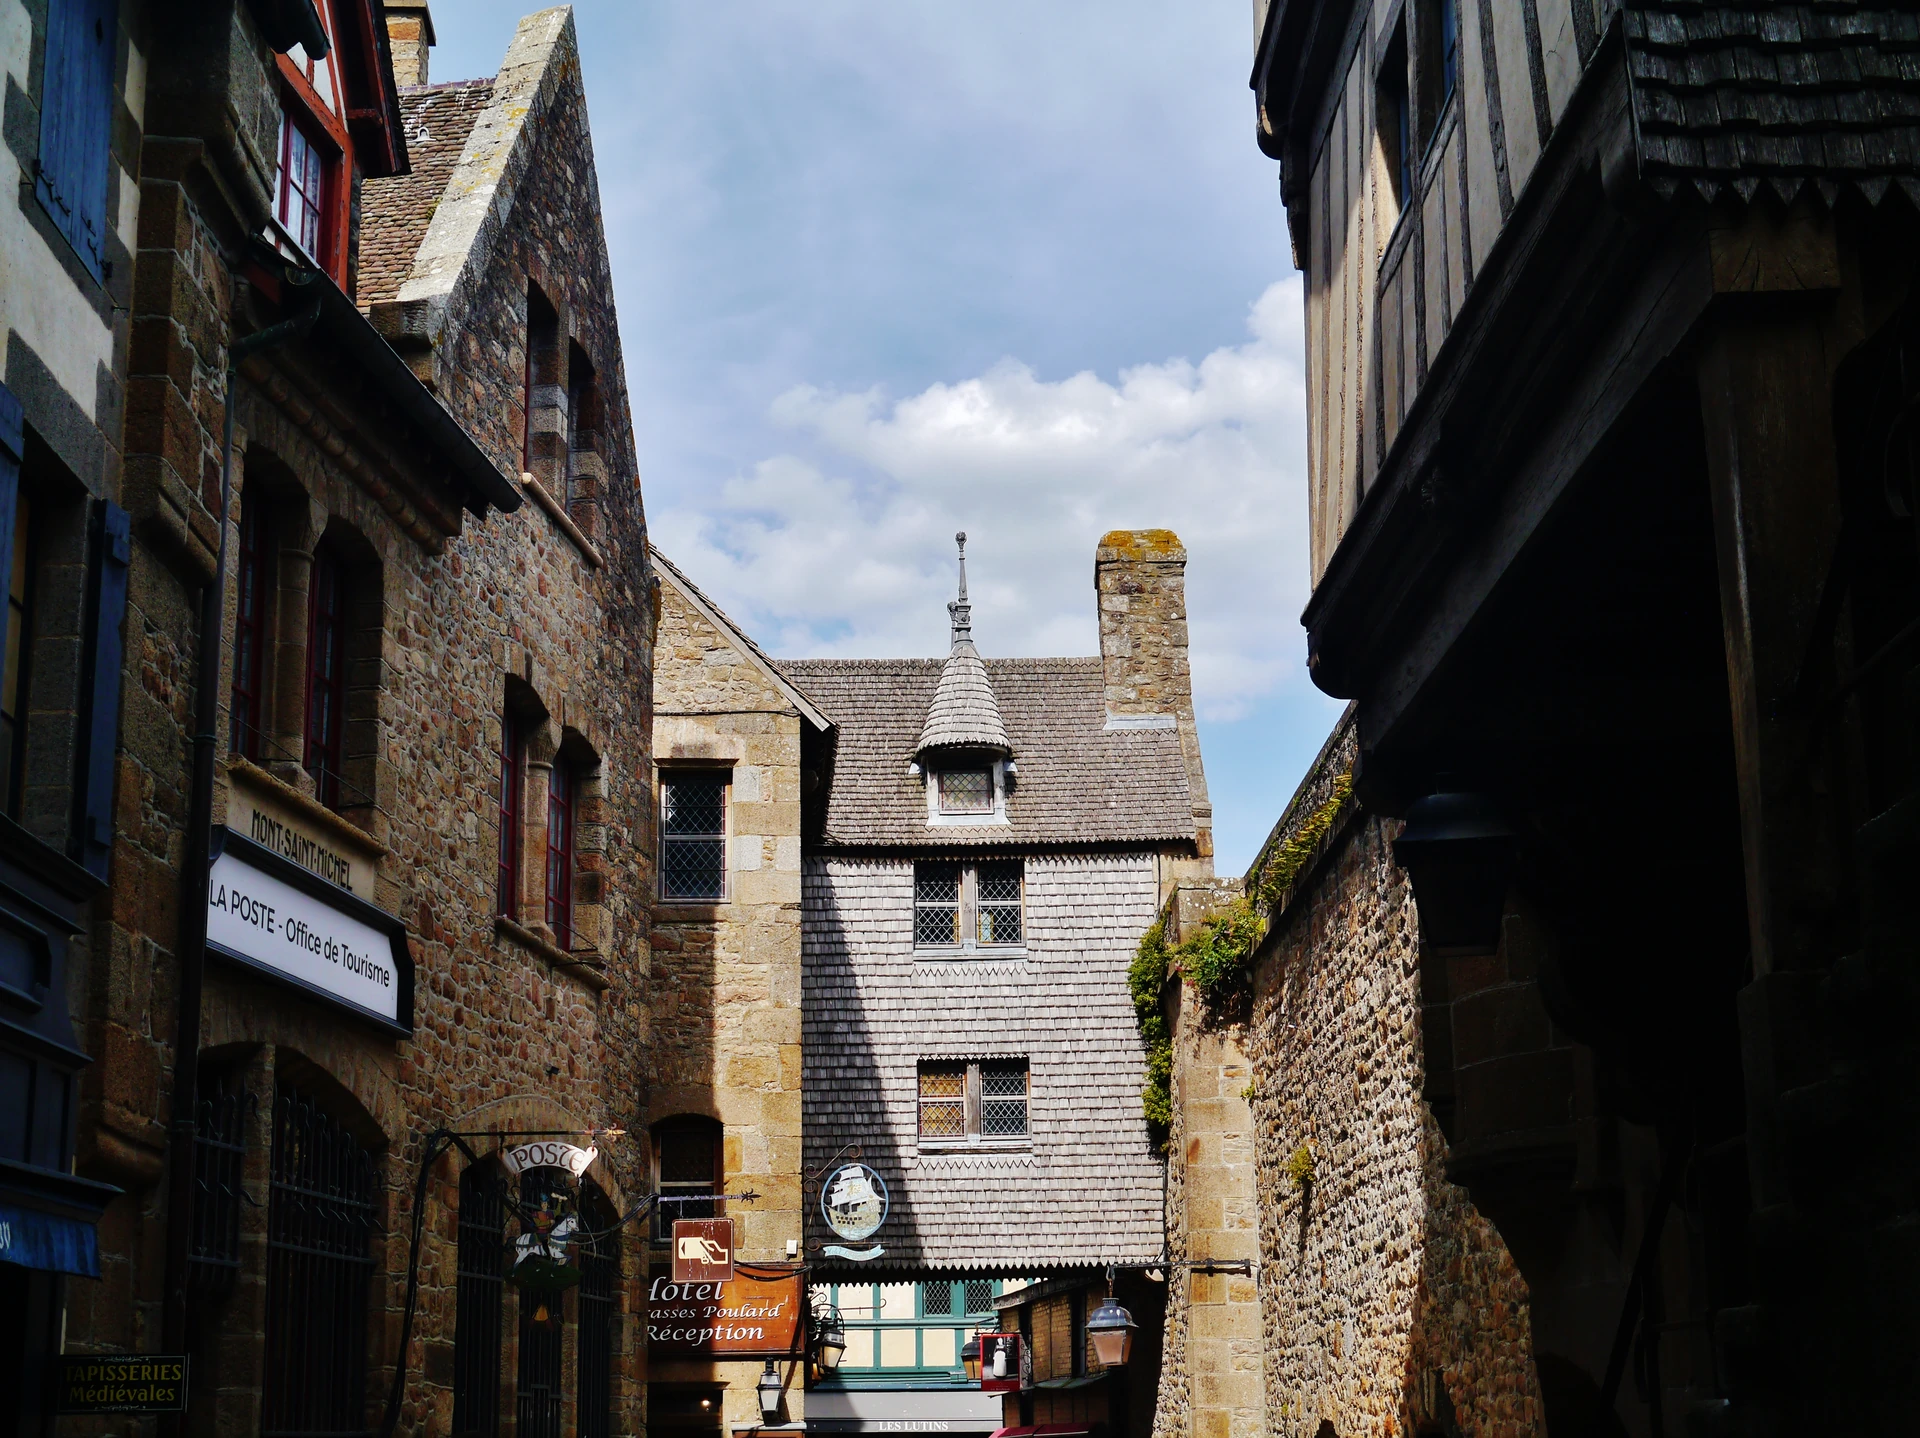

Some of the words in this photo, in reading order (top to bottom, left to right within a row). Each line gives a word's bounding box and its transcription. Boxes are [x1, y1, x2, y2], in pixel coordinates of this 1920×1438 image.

[209, 879, 227, 912] LA
[231, 889, 275, 934] POSTE
[286, 917, 321, 955] Office
[324, 936, 339, 964] de
[341, 943, 390, 988] Tourisme
[511, 1143, 585, 1171] POSTE
[648, 1308, 697, 1319] asses
[703, 1303, 785, 1319] Poulard
[647, 1323, 765, 1347] Réception
[64, 1363, 183, 1383] TAPISSERIES
[68, 1383, 176, 1404] Médiévales
[879, 1421, 902, 1431] LES
[904, 1421, 949, 1431] LUTINS
